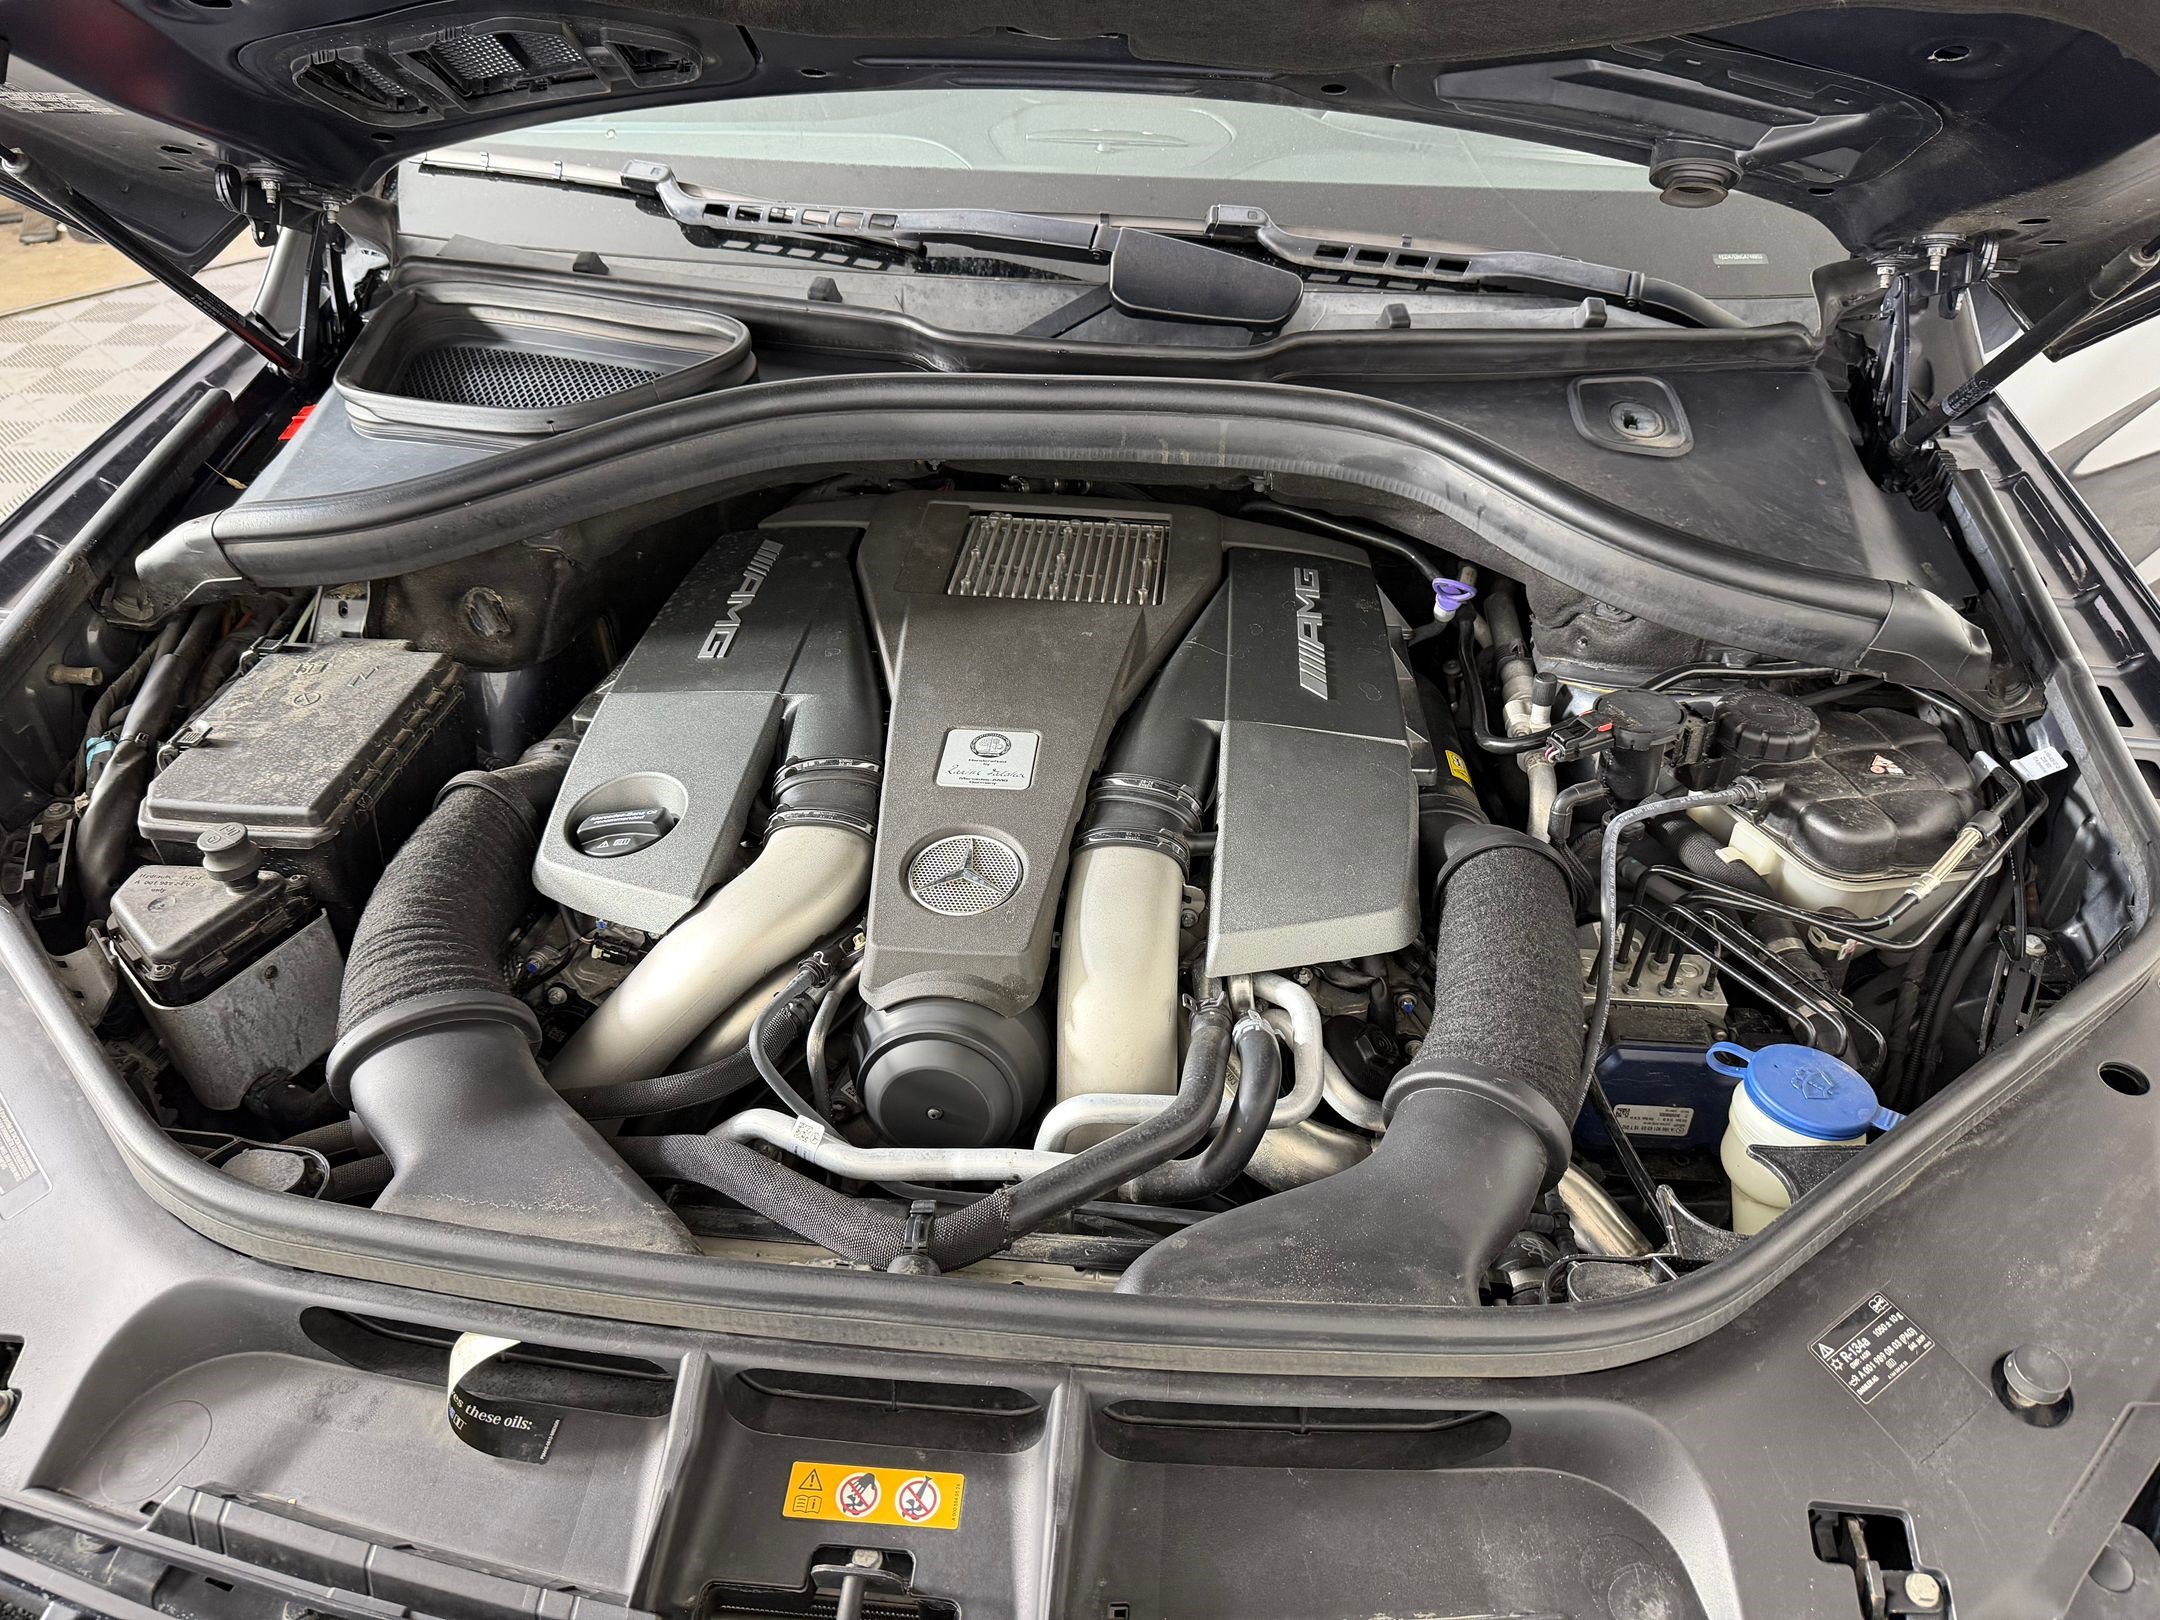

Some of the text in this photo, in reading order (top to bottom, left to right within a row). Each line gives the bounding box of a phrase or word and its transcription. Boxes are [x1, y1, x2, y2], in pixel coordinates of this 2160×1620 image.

[1840, 1337, 1871, 1363] R-134a
[1873, 1323, 1888, 1338] 1050
[1888, 1314, 1899, 1324] 10
[1858, 1370, 1866, 1380] A
[1862, 1361, 1876, 1375] 001
[1873, 1351, 1887, 1366] 989
[1883, 1345, 1895, 1356] 08
[1891, 1338, 1902, 1350] 03
[1899, 1326, 1918, 1345] (PAG)
[465, 1404, 501, 1425] these
[503, 1415, 533, 1431] oils:
